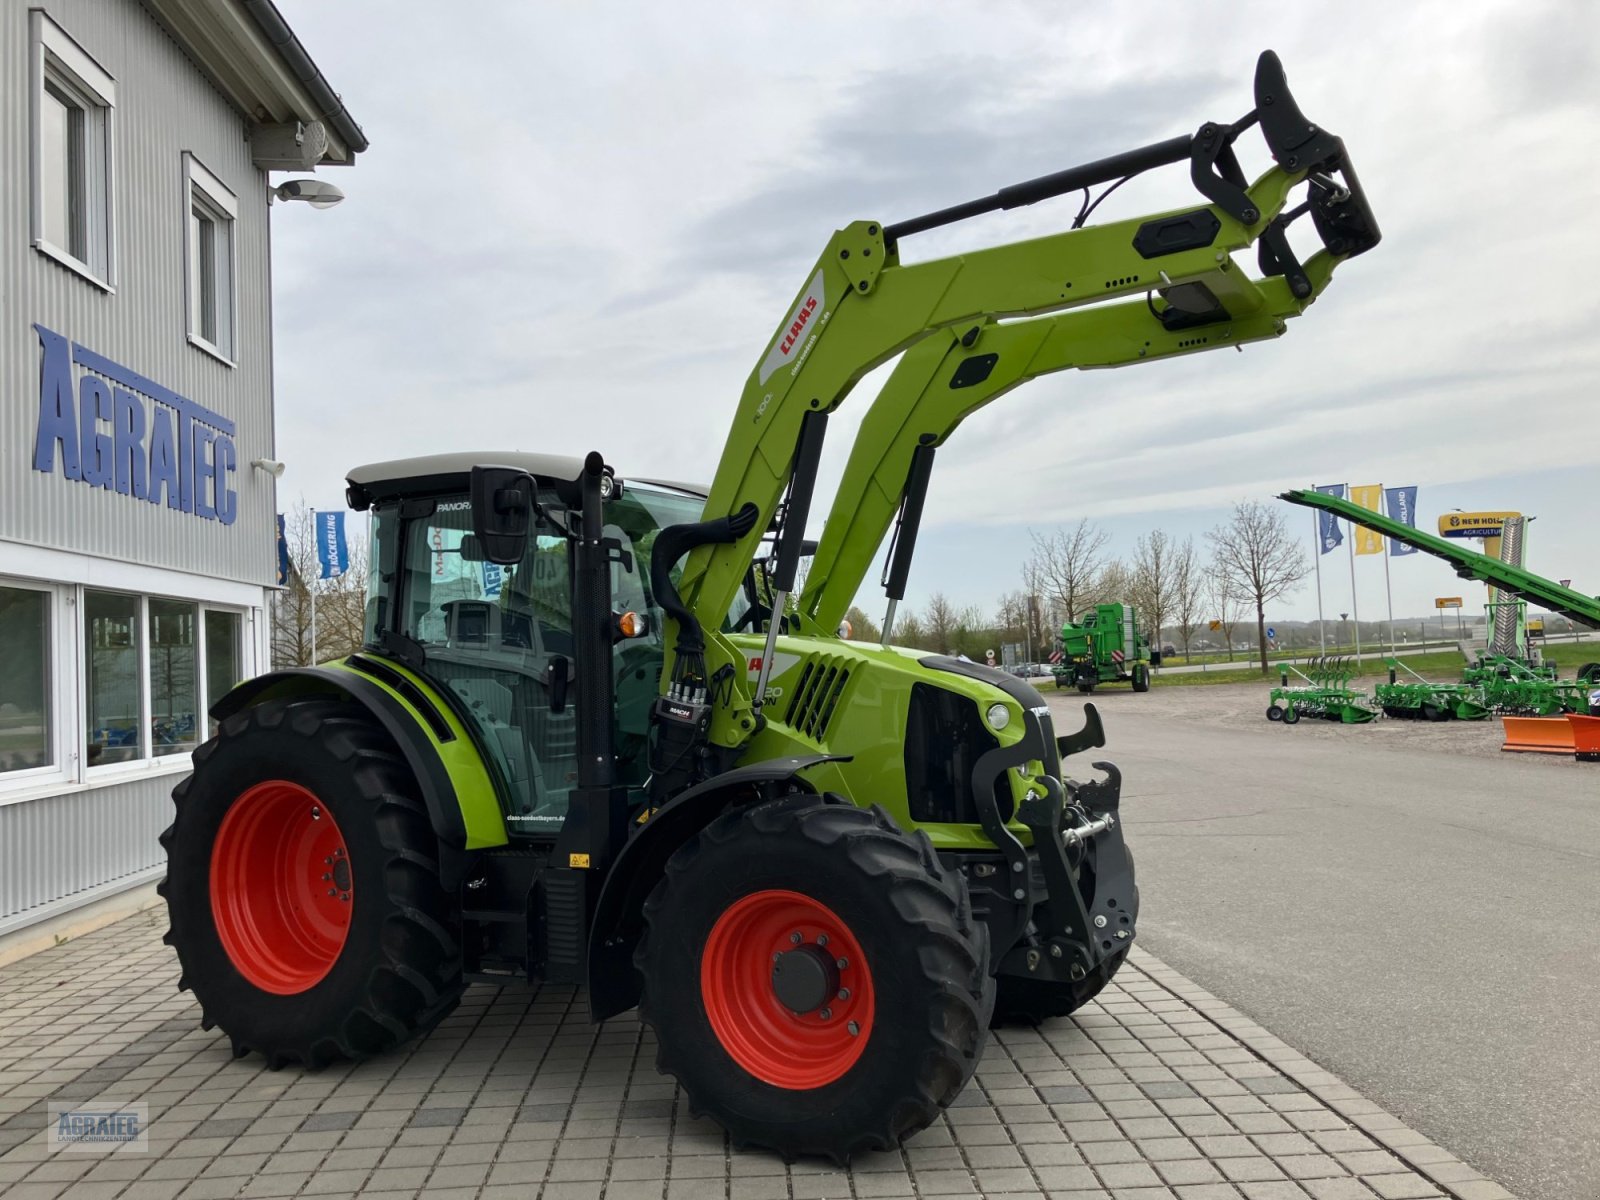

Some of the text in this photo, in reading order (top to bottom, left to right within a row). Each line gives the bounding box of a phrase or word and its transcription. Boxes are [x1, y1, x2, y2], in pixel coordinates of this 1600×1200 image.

[780, 296, 818, 356] CLAAS
[32, 322, 237, 525] AGRATEC
[1398, 491, 1408, 524] HOLLAND
[1462, 517, 1480, 525] NEW
[327, 514, 338, 566] KÖCKERLING
[765, 687, 783, 698] 20
